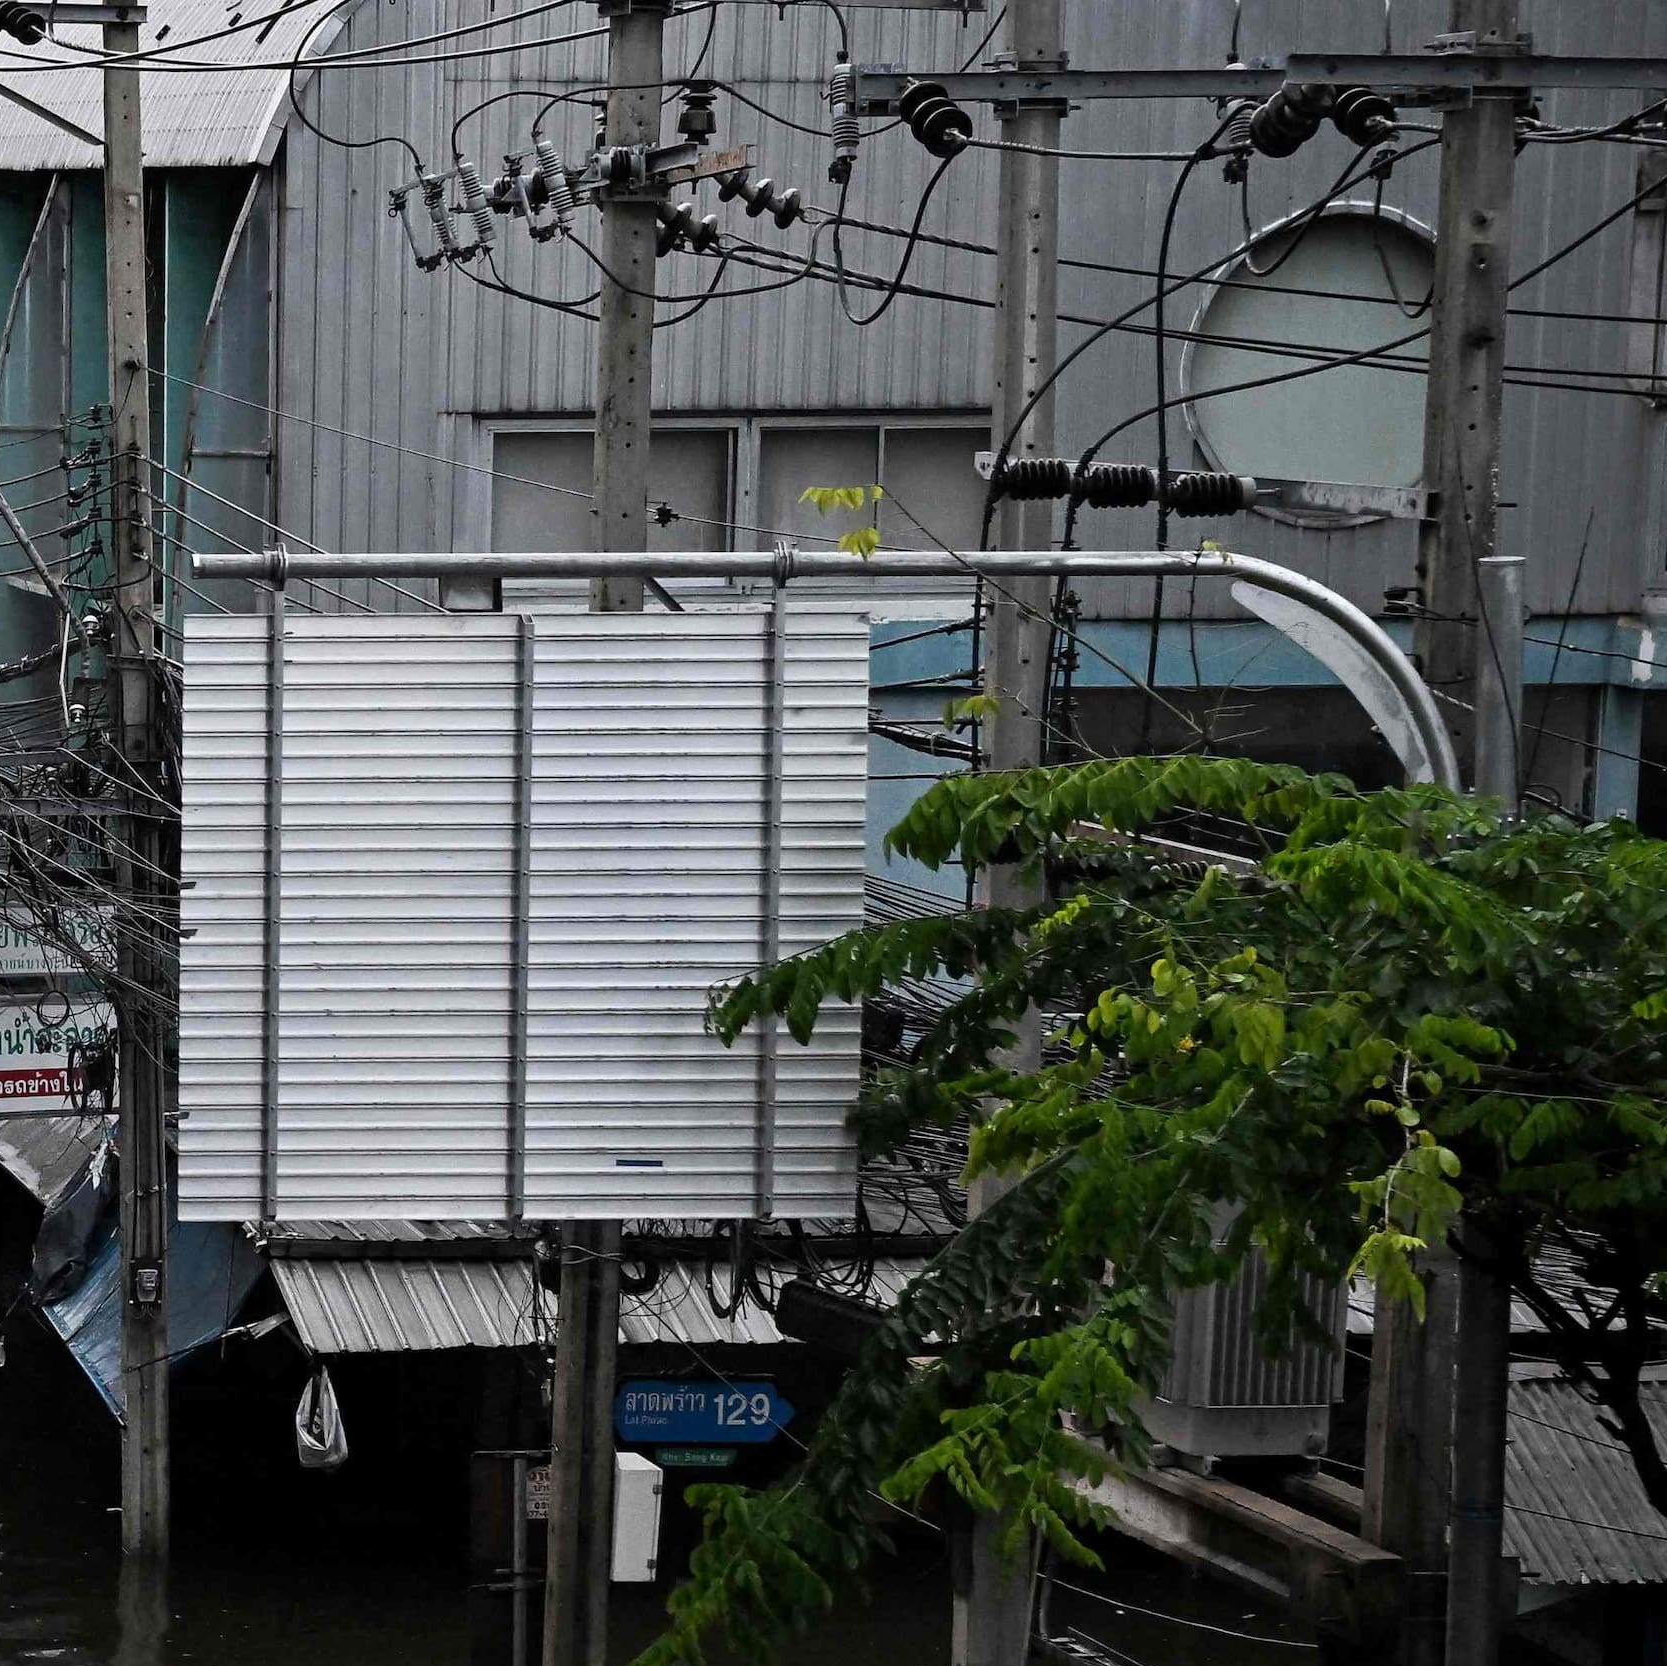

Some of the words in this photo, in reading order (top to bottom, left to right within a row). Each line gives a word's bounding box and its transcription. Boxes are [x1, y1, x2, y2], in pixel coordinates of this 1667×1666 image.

[624, 1385, 706, 1412] ลาดพร้าว
[713, 1392, 771, 1426] 129
